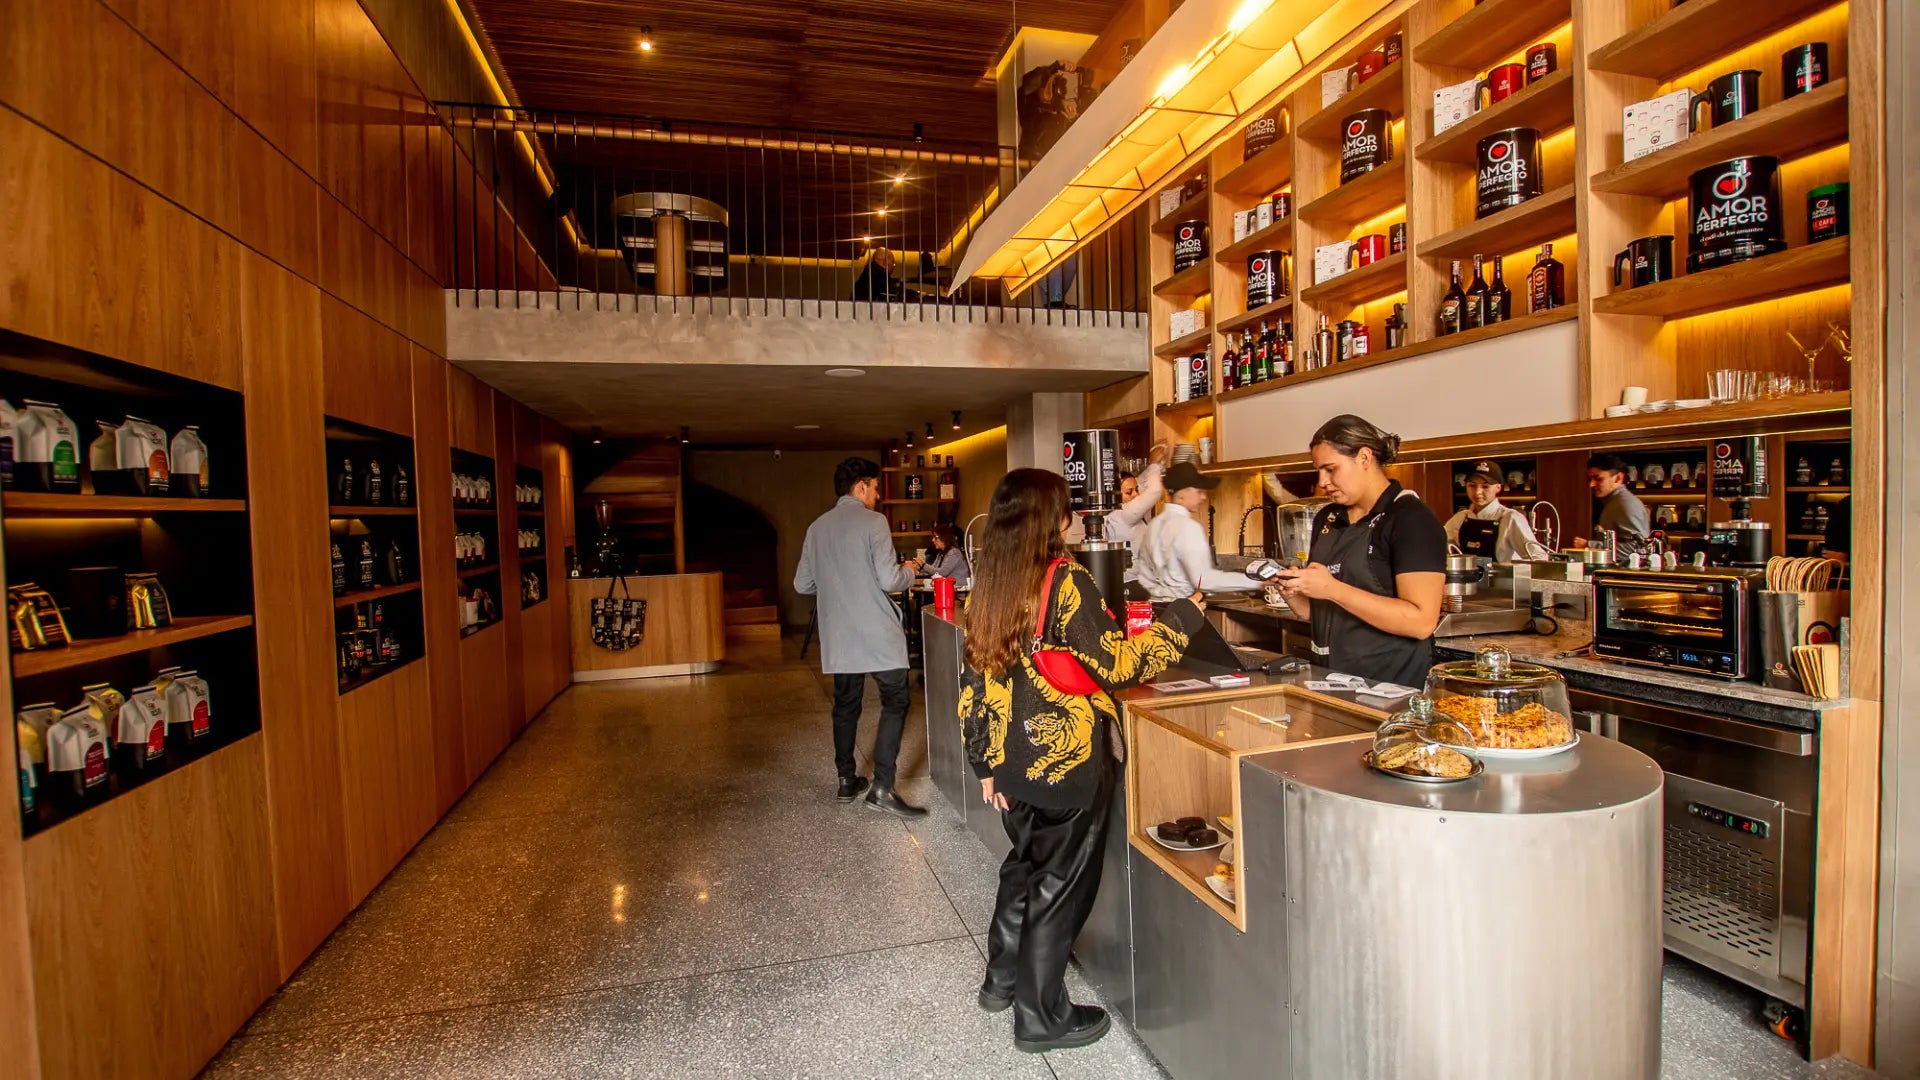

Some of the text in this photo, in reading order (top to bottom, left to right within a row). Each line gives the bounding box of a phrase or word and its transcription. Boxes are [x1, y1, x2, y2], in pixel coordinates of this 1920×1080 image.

[1479, 158, 1527, 181] AMOR
[1696, 196, 1767, 224] AMOR
[1696, 212, 1768, 234] PERFECTO
